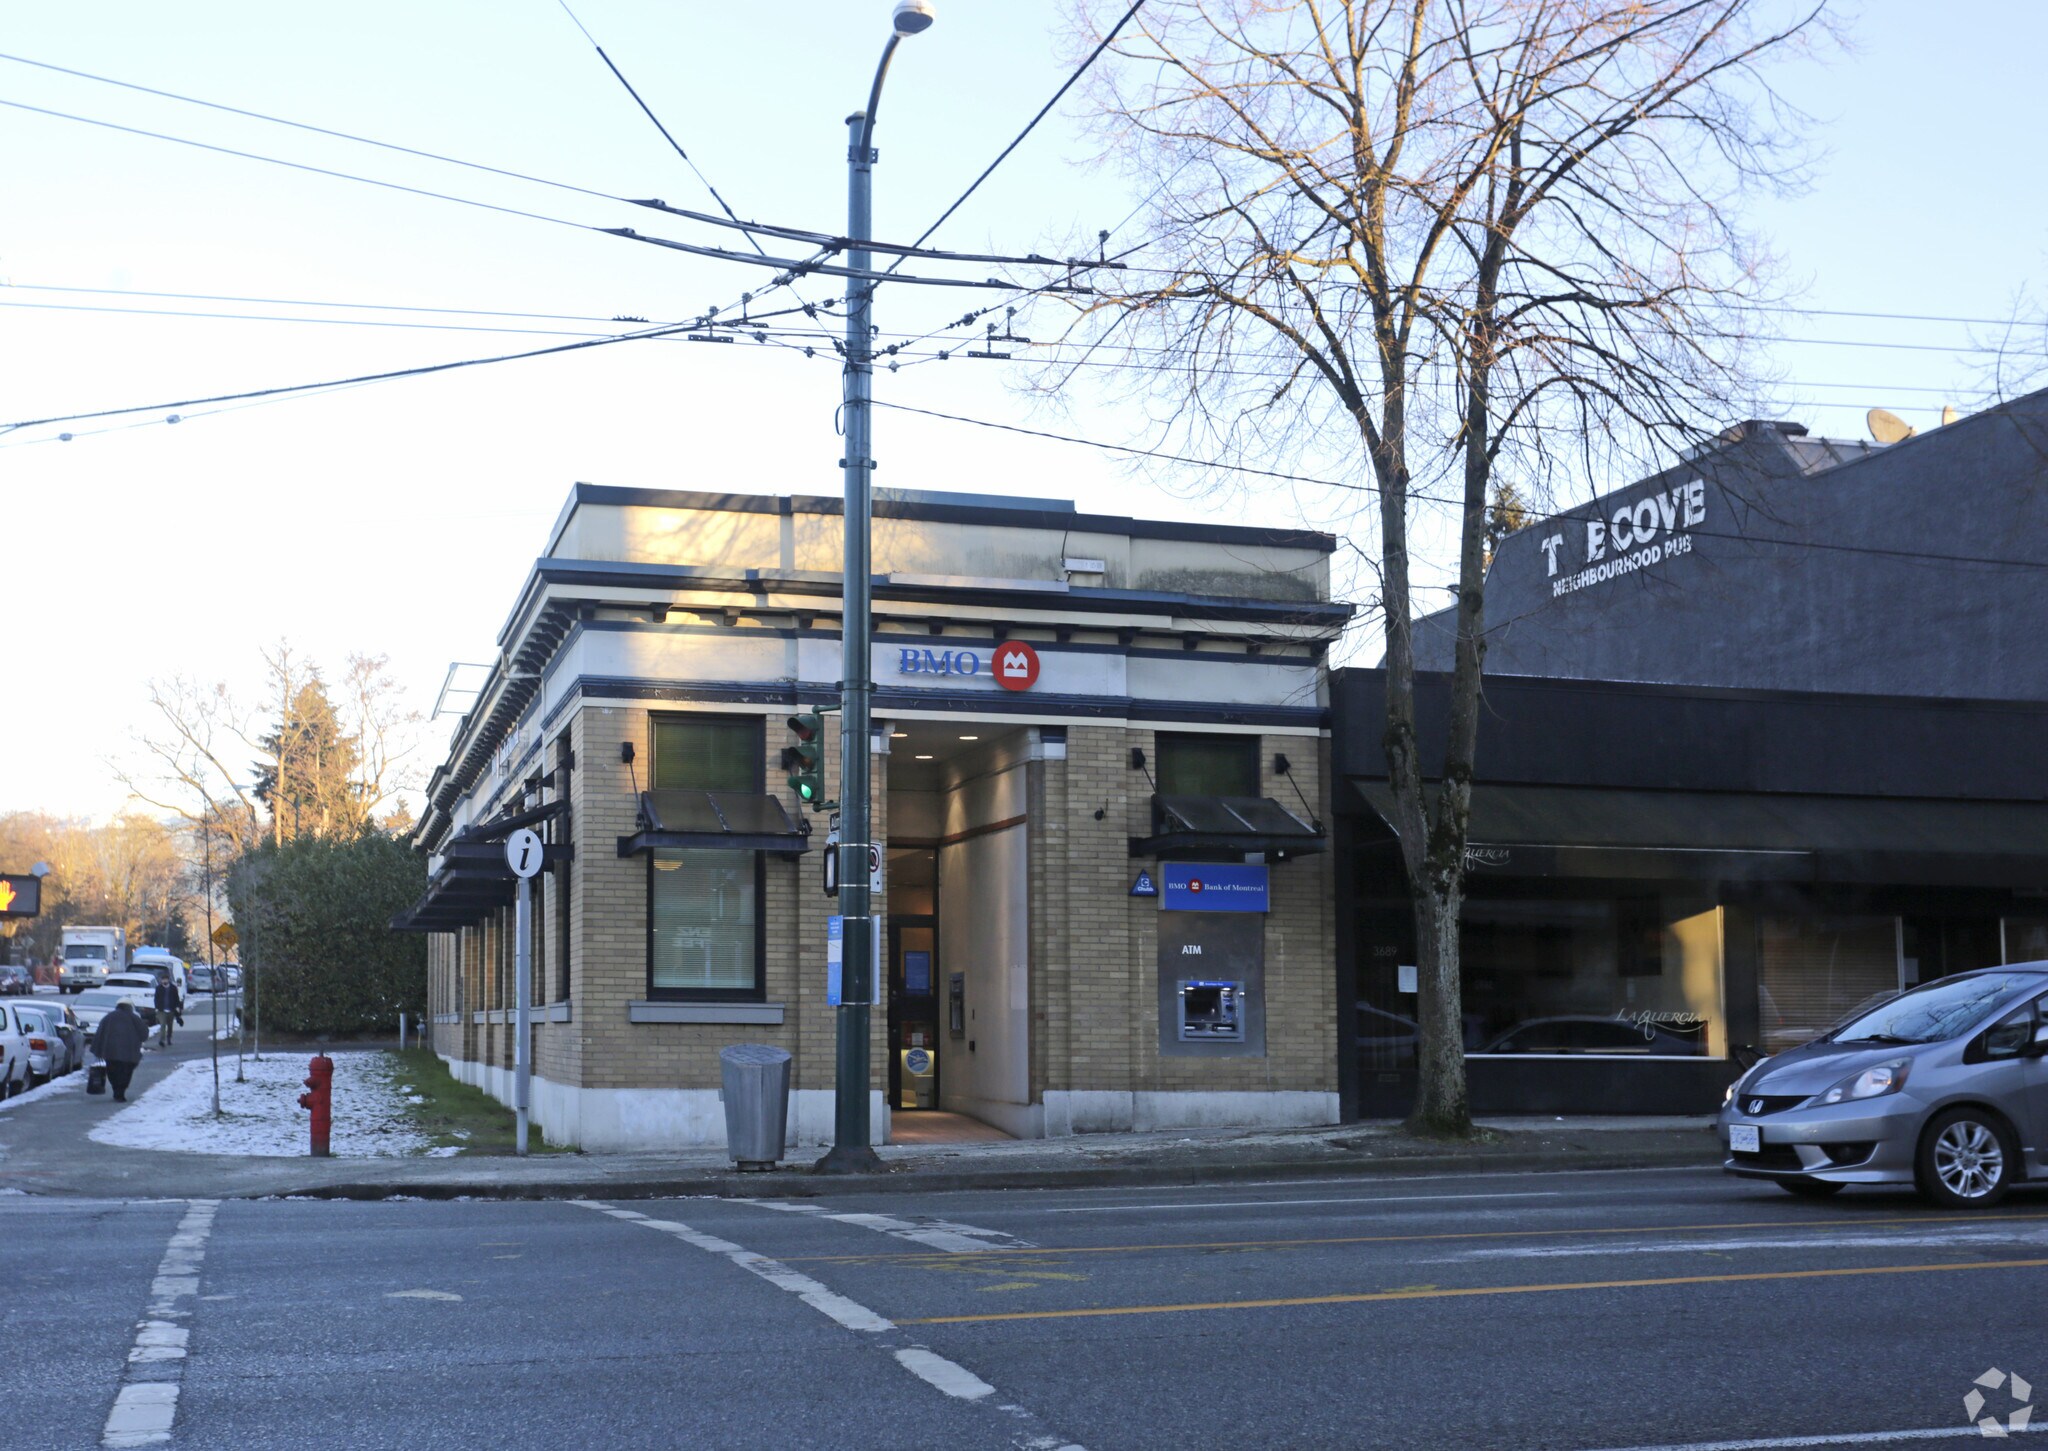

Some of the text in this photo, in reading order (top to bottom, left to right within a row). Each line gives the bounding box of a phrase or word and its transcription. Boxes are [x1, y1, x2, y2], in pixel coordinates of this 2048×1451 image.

[1553, 534, 1692, 597] NEIGHBOURHOOD PUB
[899, 648, 980, 676] BMO
[1168, 882, 1264, 892] BMO Bank of Montreal
[1182, 945, 1202, 955] ATM
